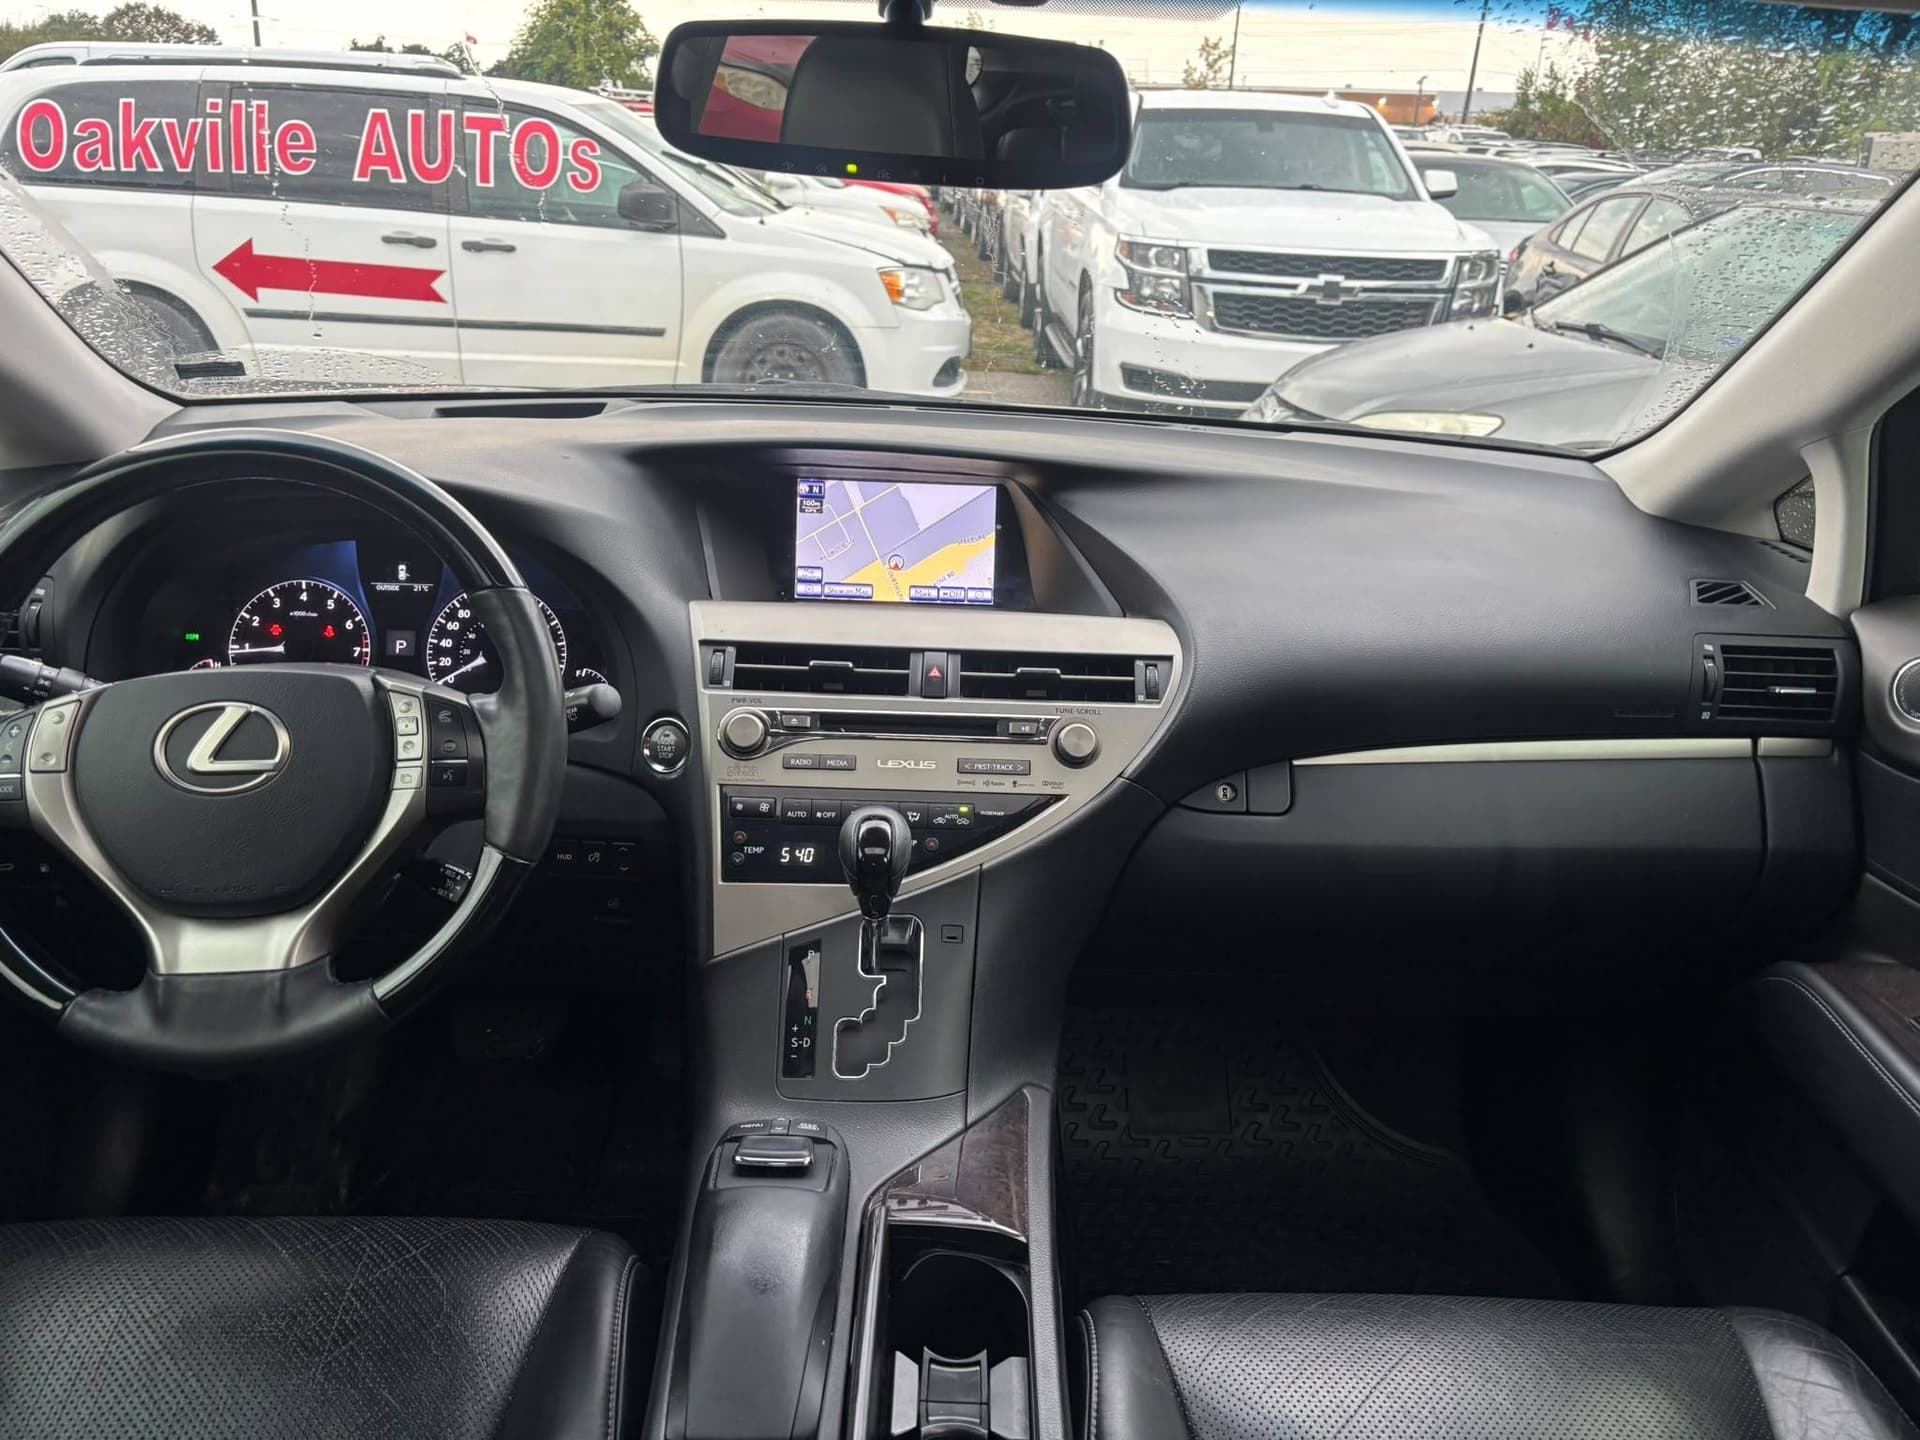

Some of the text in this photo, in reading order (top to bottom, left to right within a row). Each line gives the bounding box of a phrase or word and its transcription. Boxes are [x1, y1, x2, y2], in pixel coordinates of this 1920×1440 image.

[16, 98, 601, 193] Oakville AUTOs
[300, 592, 308, 601] 4
[273, 598, 281, 608] 3
[327, 600, 335, 609] 5
[458, 609, 471, 618] 80
[252, 616, 260, 626] 2
[345, 620, 354, 630] 6
[446, 622, 460, 630] 60
[395, 640, 407, 655] P
[439, 639, 452, 648] 40
[353, 647, 361, 657] 7
[439, 658, 452, 666] 20
[790, 758, 848, 767] RADIO MEDIA
[877, 759, 937, 769] LEXUS
[743, 846, 765, 854] TEMP
[804, 1015, 812, 1025] N
